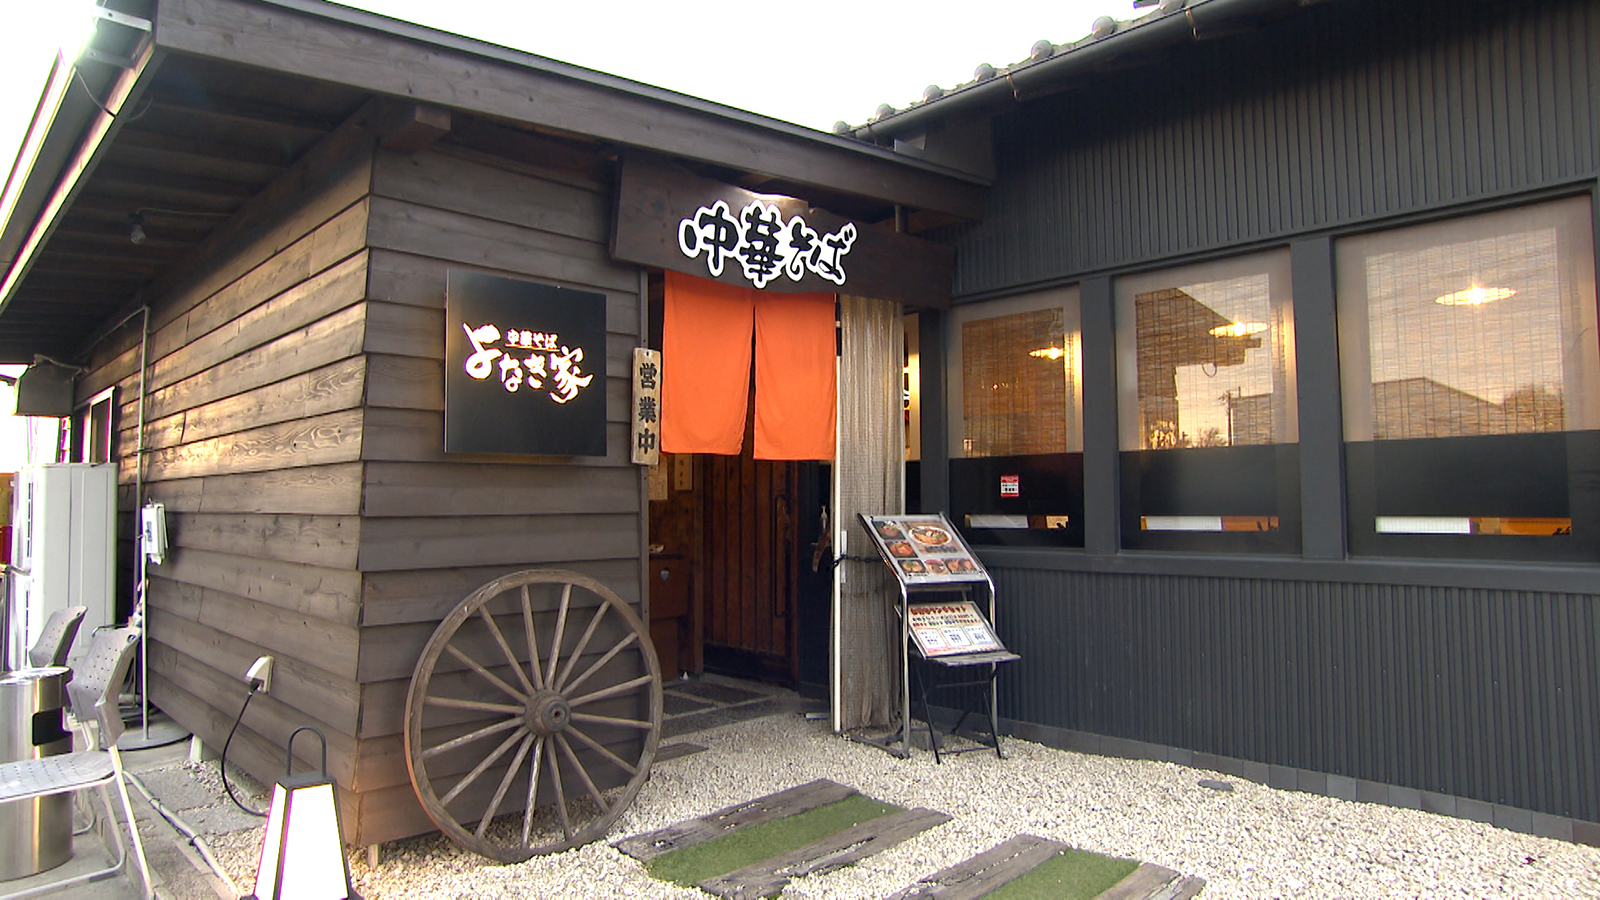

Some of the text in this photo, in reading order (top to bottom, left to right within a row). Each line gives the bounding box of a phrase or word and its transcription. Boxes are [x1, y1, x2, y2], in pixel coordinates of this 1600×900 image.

[678, 200, 858, 289] 中華そば
[506, 328, 559, 349] 中華そば
[638, 362, 658, 454] 営業中
